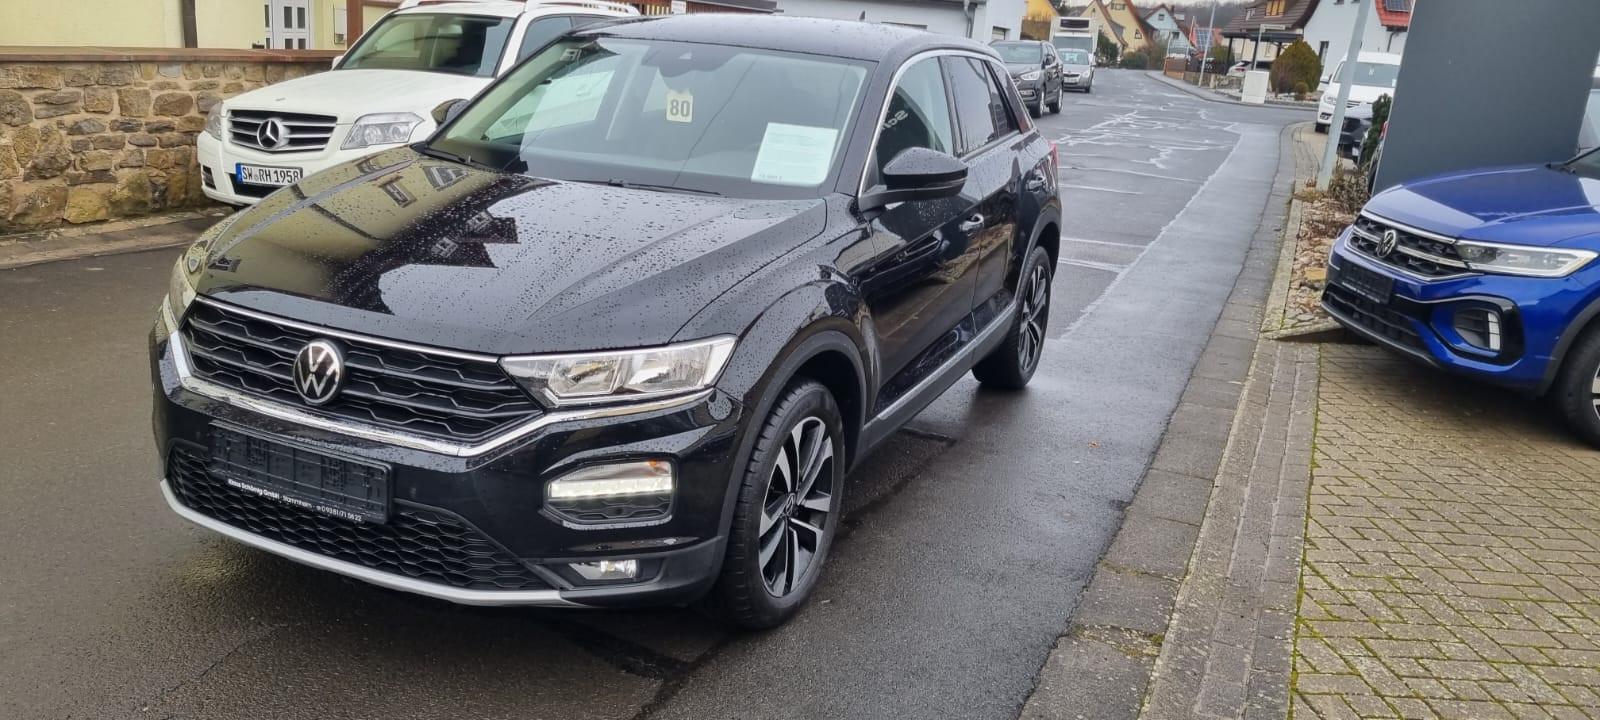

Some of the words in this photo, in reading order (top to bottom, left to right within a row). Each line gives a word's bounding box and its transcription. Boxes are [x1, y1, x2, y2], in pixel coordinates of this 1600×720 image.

[670, 99, 690, 117] 80
[242, 167, 253, 180] SW
[259, 169, 272, 182] RH
[274, 170, 299, 183] 1958
